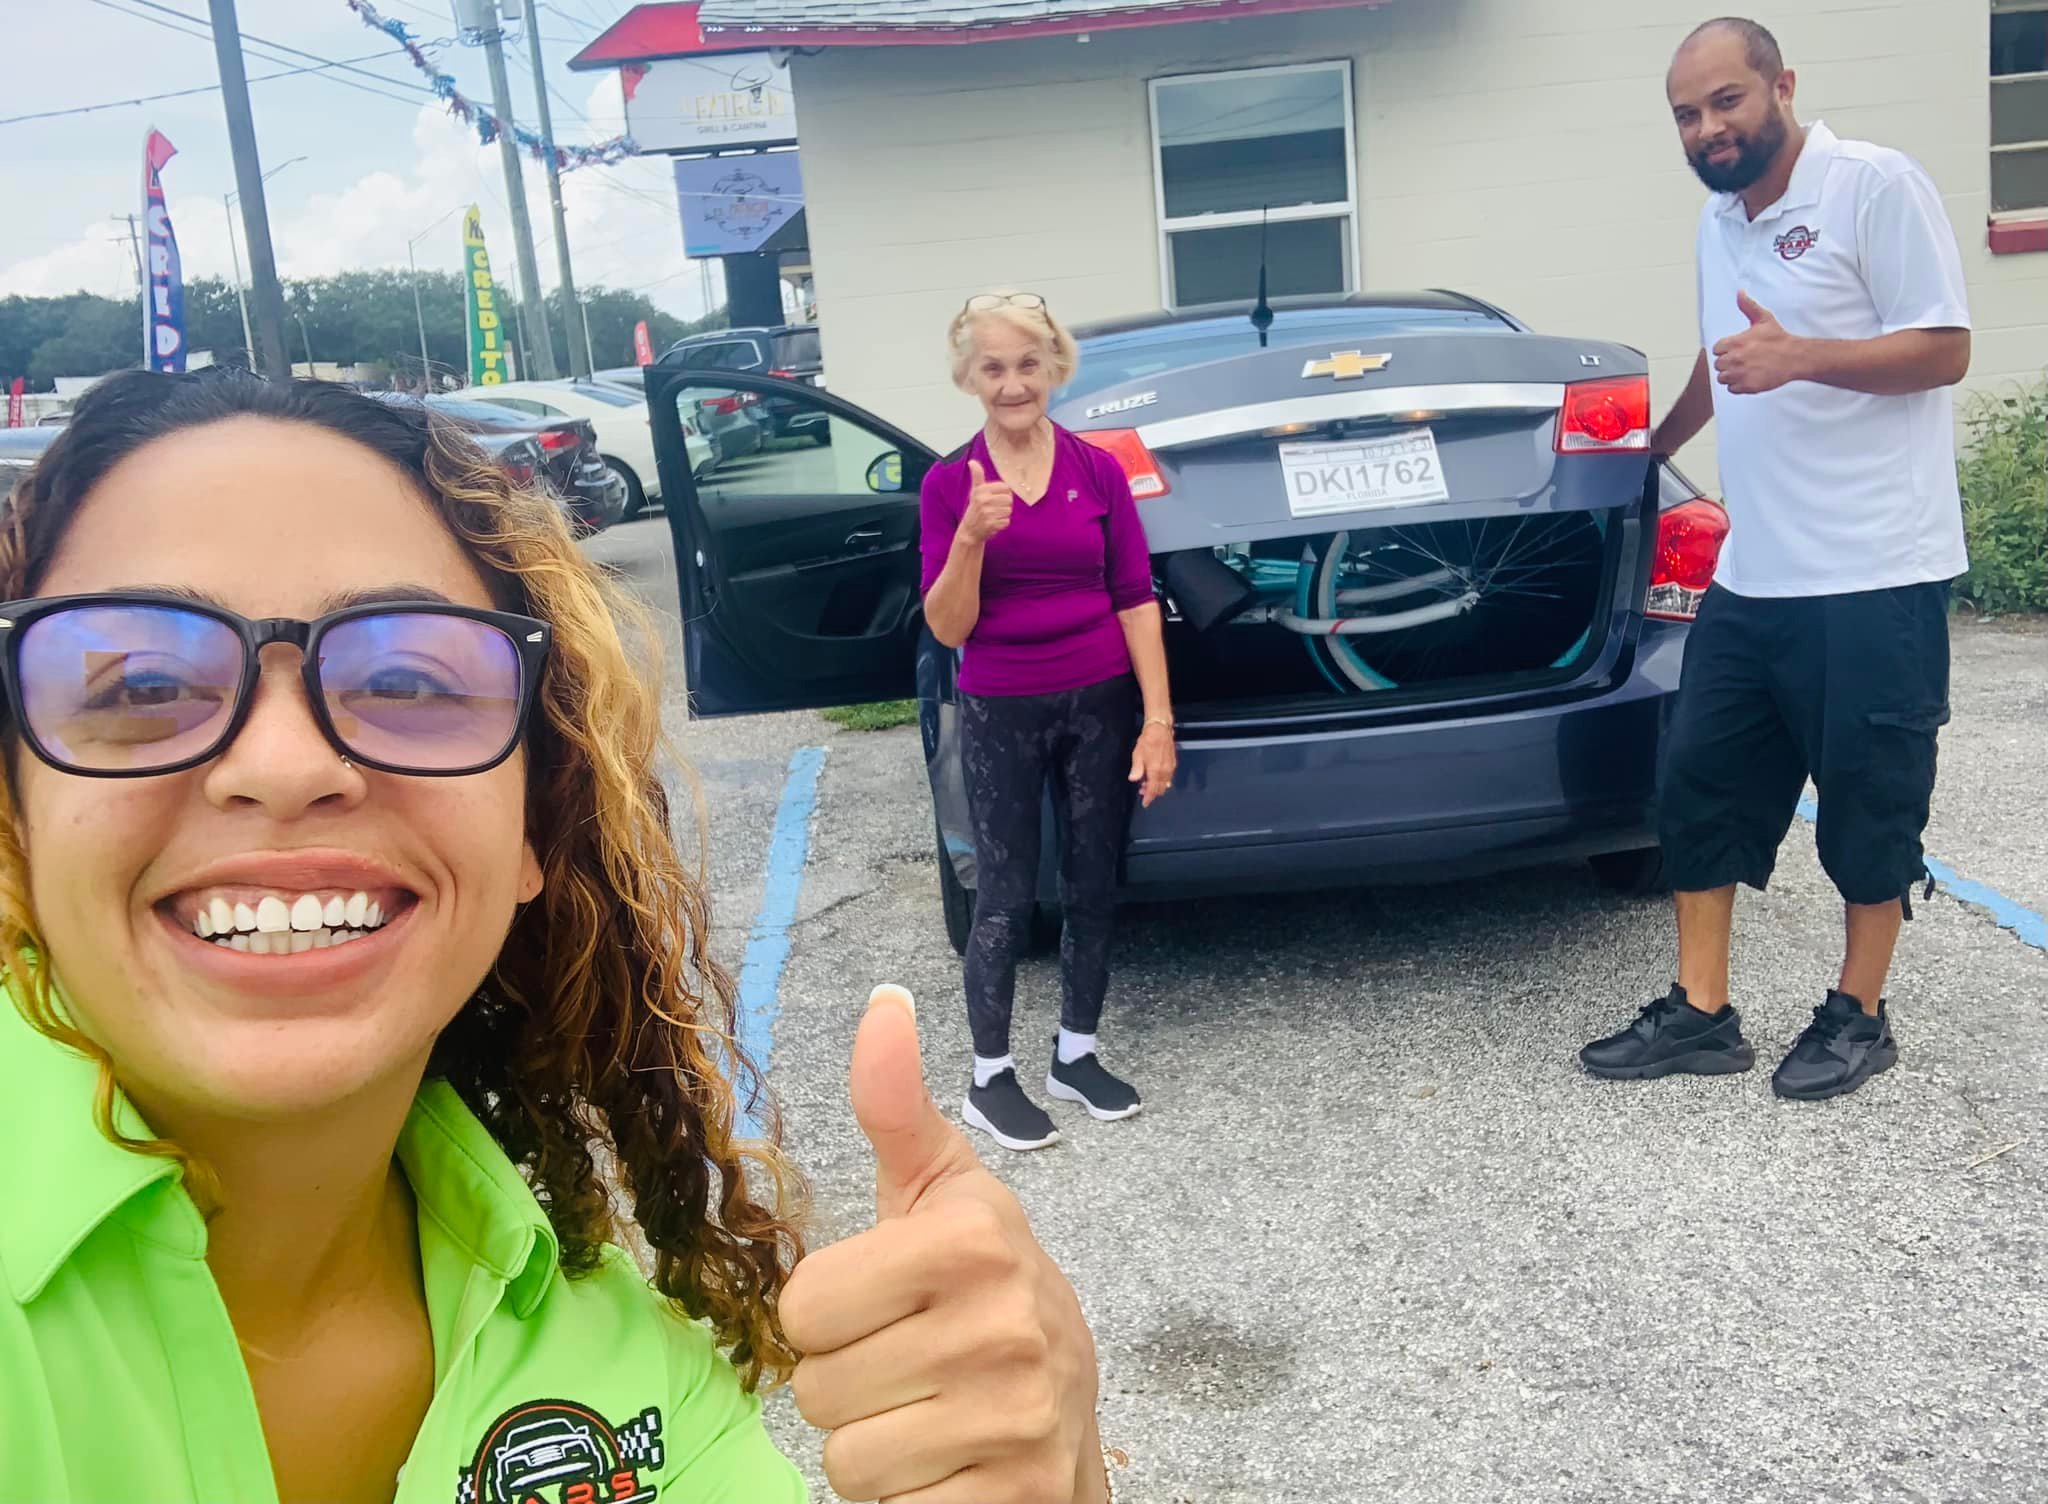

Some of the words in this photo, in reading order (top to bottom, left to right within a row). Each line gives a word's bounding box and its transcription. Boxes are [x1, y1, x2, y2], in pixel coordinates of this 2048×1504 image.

[472, 250, 503, 386] CREDITO
[1580, 354, 1601, 367] LT
[1086, 391, 1158, 419] CRUZE
[1294, 457, 1434, 496] DKI1762
[1346, 488, 1389, 499] FLORIDA
